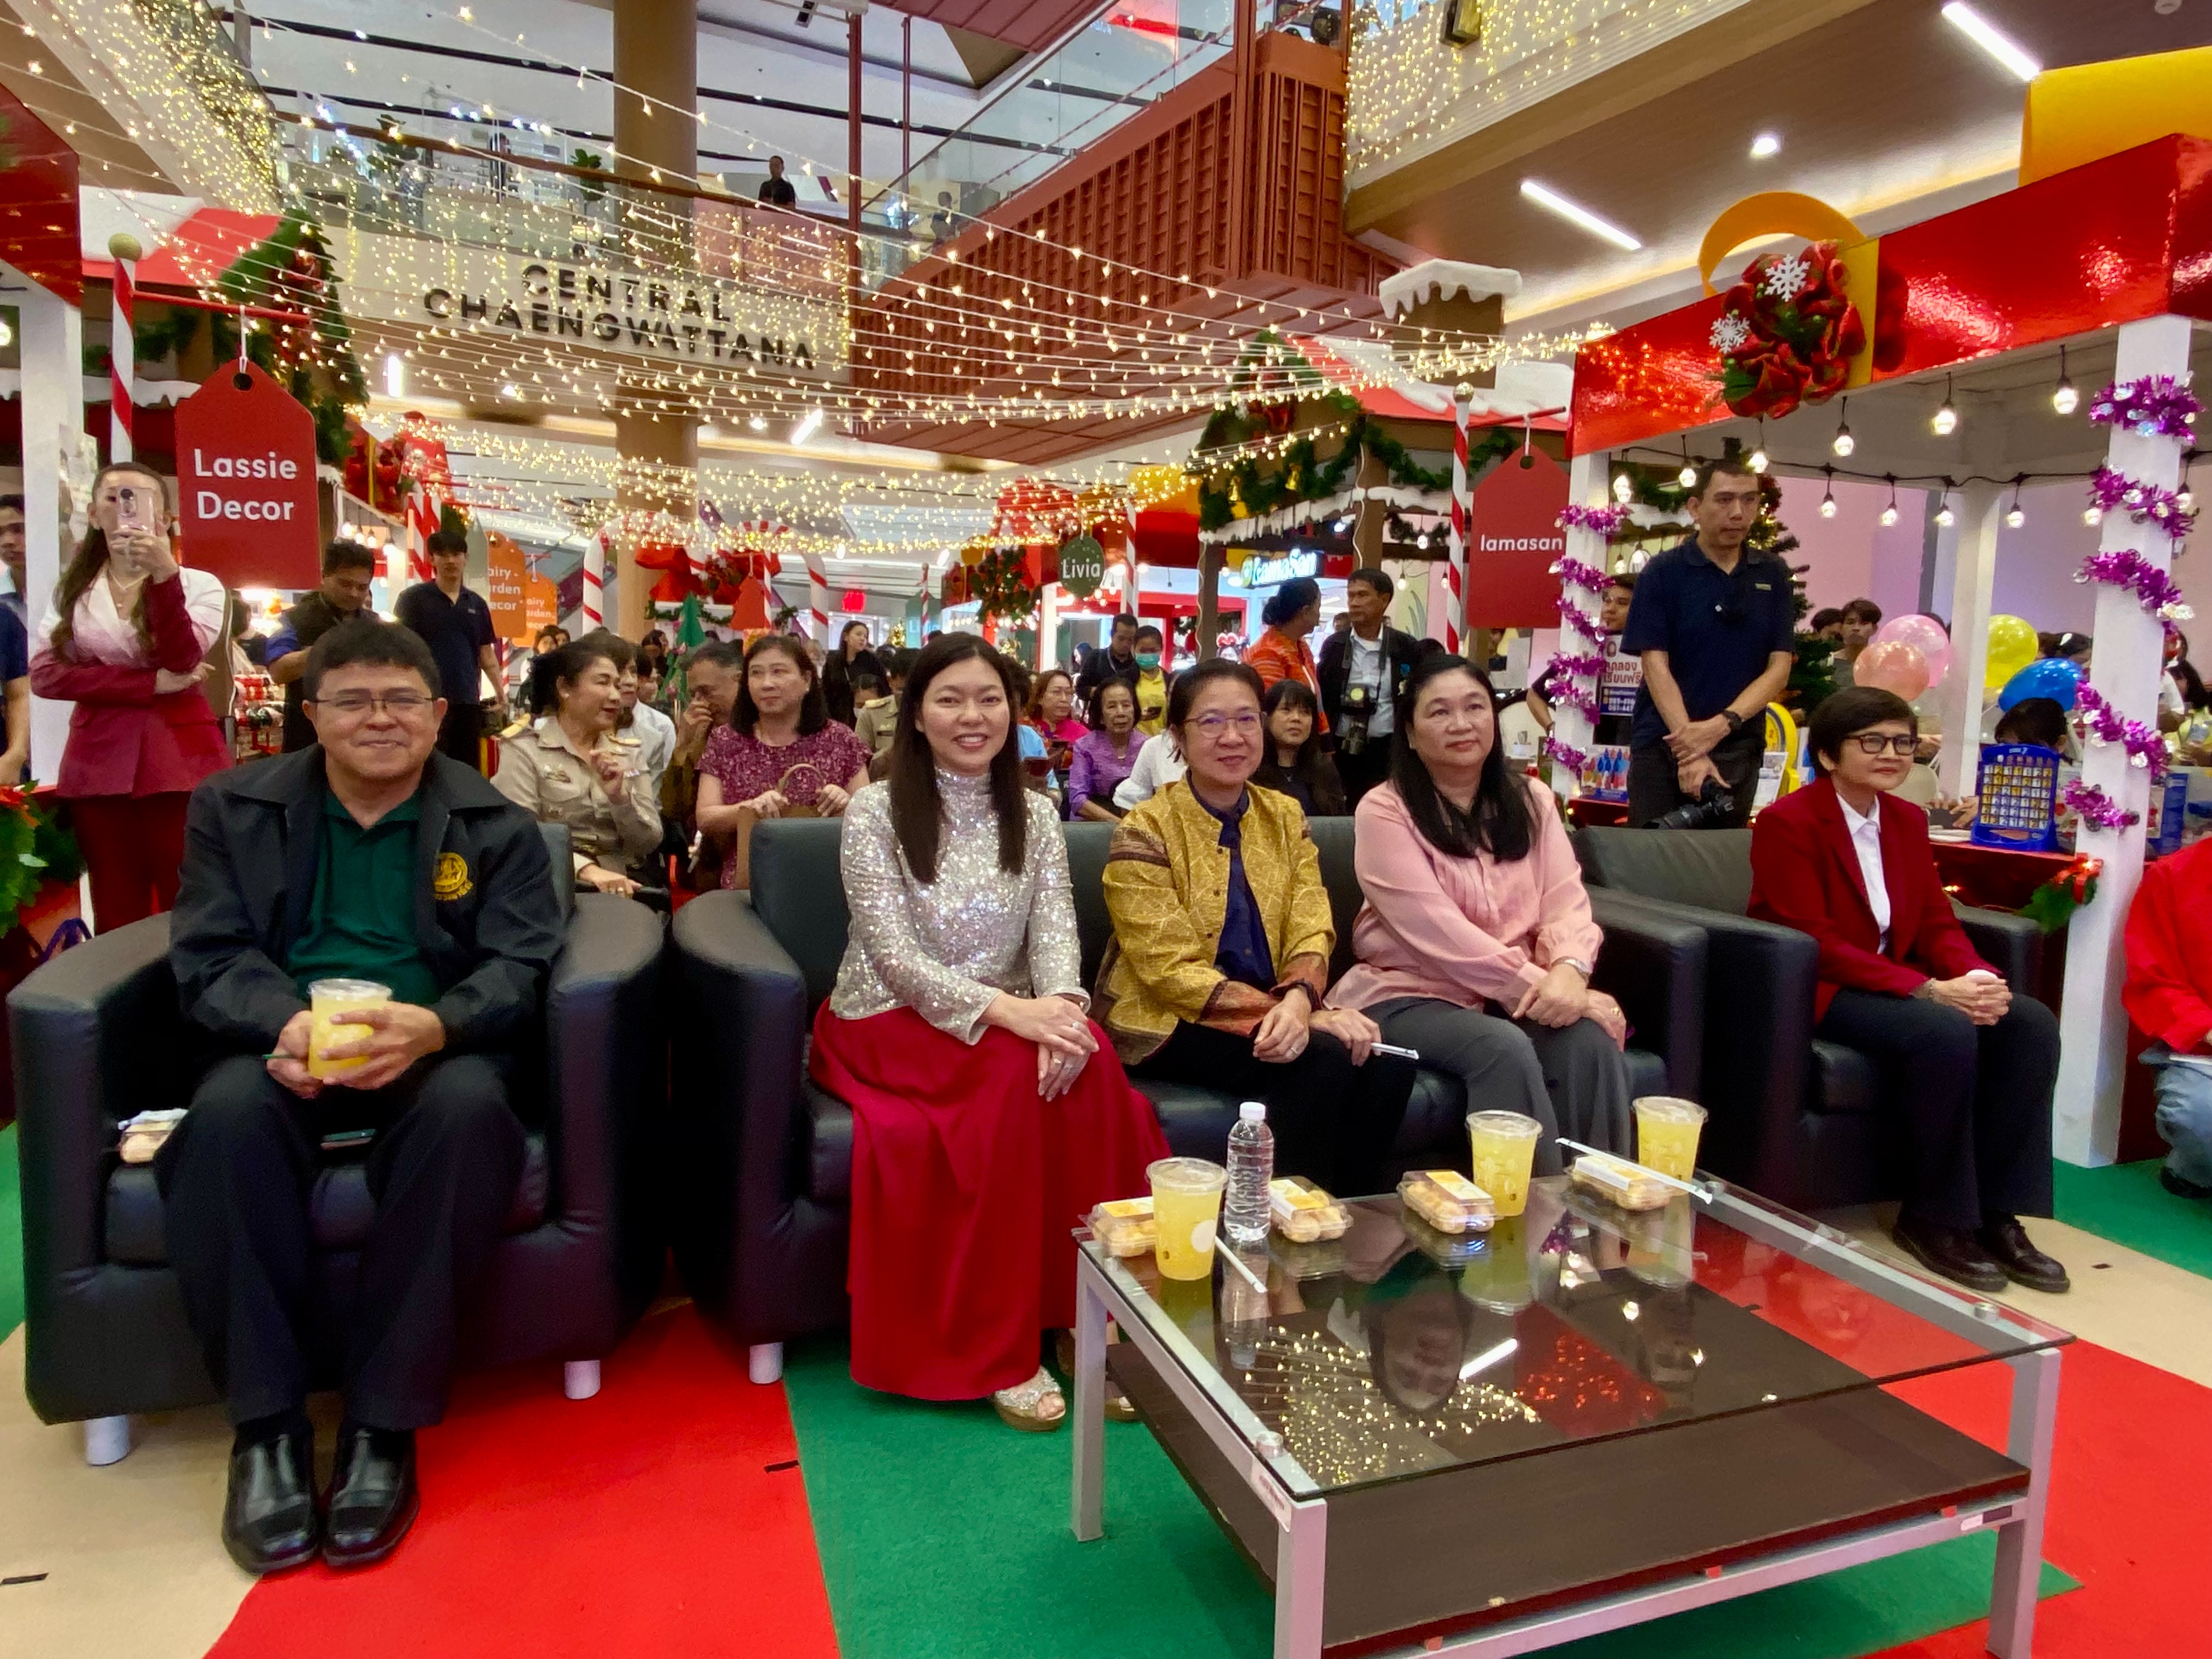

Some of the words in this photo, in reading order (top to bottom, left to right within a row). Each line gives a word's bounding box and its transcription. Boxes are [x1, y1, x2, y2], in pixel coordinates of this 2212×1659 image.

[522, 264, 731, 323] CENTRAL
[423, 287, 816, 371] CHAENGWATTANA
[193, 448, 298, 480] Lassie
[197, 490, 295, 521] Decor
[1480, 533, 1562, 552] lamasan
[488, 565, 511, 580] airy
[1062, 558, 1101, 579] Livia
[489, 582, 521, 595] rden
[489, 601, 517, 611] ecor
[526, 597, 545, 607] airy
